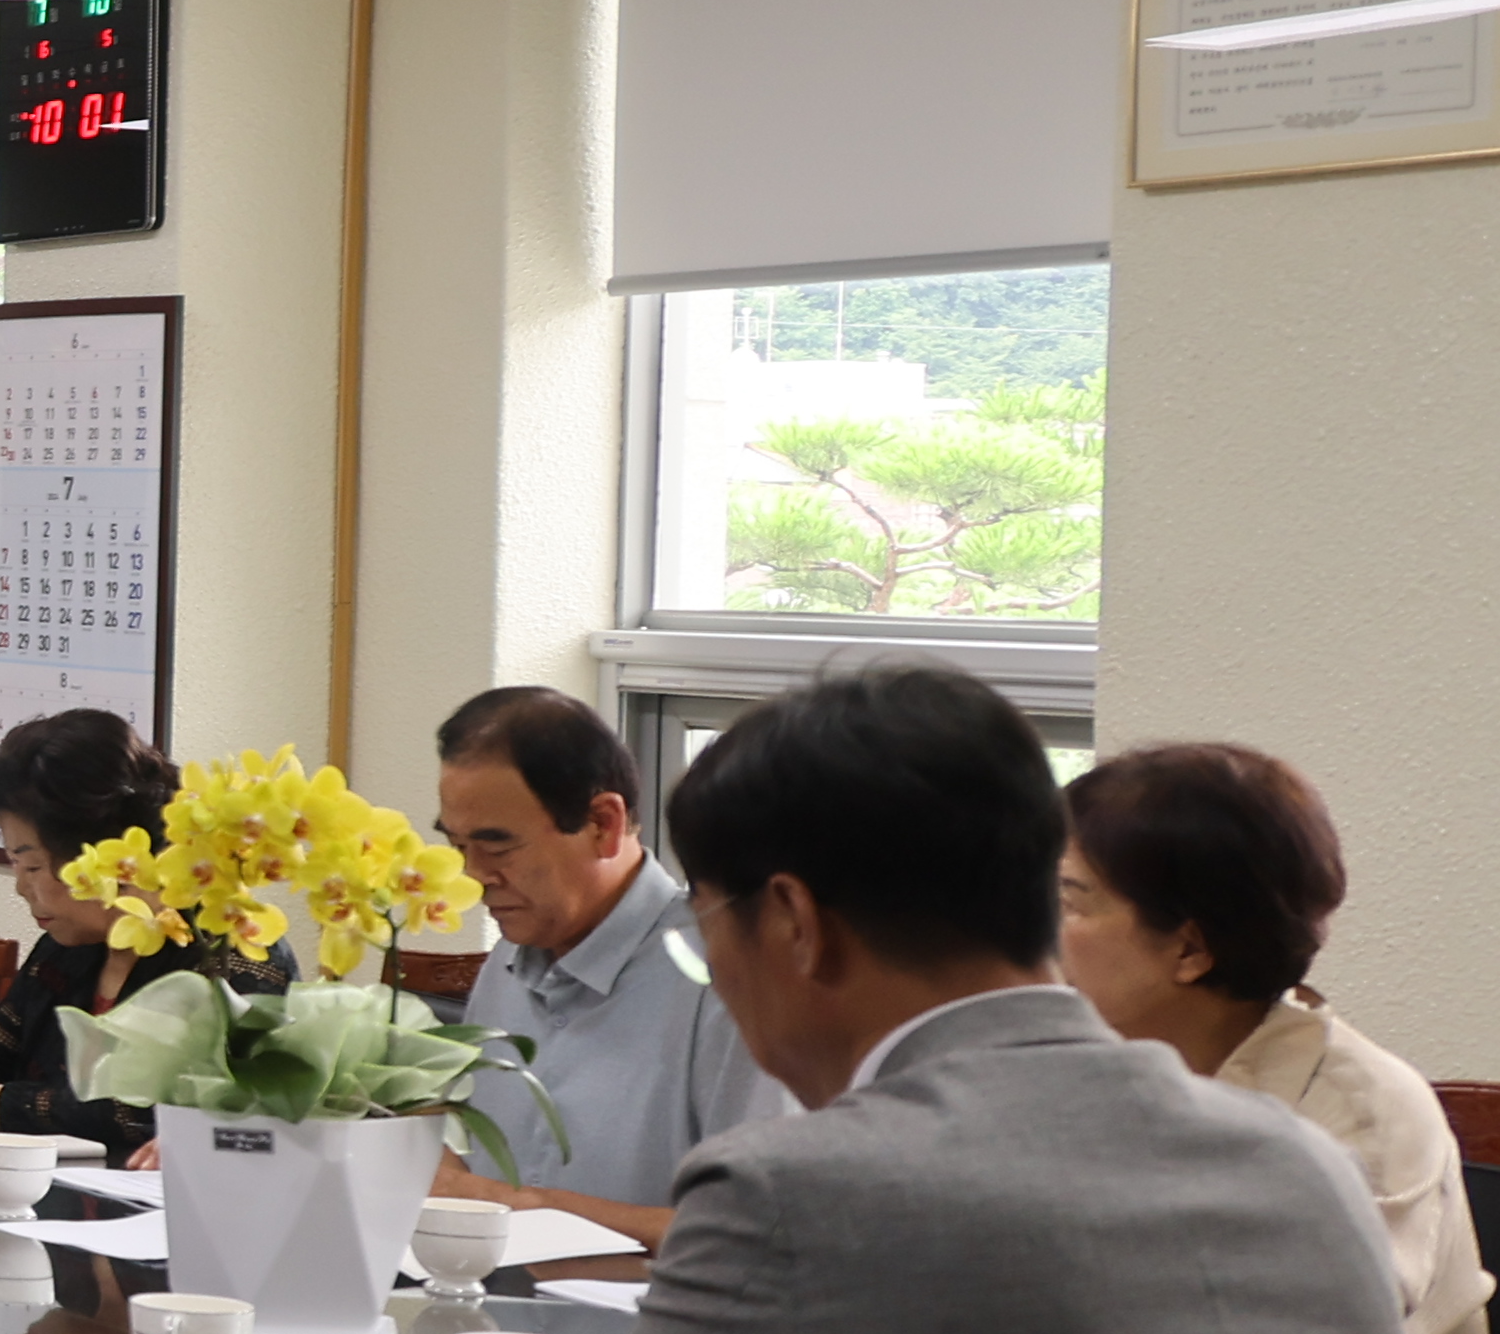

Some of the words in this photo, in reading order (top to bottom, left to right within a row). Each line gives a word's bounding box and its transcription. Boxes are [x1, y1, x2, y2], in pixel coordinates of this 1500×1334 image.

[37, 40, 50, 58] 6
[101, 28, 113, 48] 5
[71, 333, 78, 349] 6
[139, 365, 144, 377] 1
[7, 388, 12, 400] 2
[27, 388, 32, 400] 3
[48, 388, 54, 399] 4
[70, 387, 76, 399] 5
[92, 387, 97, 399] 6
[115, 386, 121, 398] 7
[139, 386, 145, 398] 8
[6, 408, 11, 419] 9
[24, 408, 33, 419] 10
[45, 408, 55, 419] 11
[67, 407, 76, 419] 12
[89, 407, 99, 419] 13
[112, 407, 122, 418] 14
[137, 407, 146, 419] 15
[3, 428, 12, 440] 16
[24, 427, 33, 439] 17
[44, 428, 54, 439] 18
[66, 428, 75, 439] 19
[88, 428, 99, 440] 20
[112, 427, 121, 440] 21
[135, 428, 146, 440] 22
[23, 448, 32, 460] 24
[43, 448, 53, 460] 25
[65, 448, 75, 460] 26
[87, 448, 98, 460] 27
[111, 448, 122, 461] 28
[135, 448, 146, 461] 29
[64, 477, 74, 500] 7
[23, 521, 28, 537] 1
[43, 521, 50, 538] 2
[65, 522, 71, 538] 3
[87, 523, 94, 538] 4
[110, 523, 117, 540] 5
[133, 525, 141, 541] 6
[2, 548, 8, 563] 7
[22, 549, 28, 565] 8
[43, 550, 49, 566] 9
[62, 551, 73, 567] 10
[85, 552, 94, 568] 11
[107, 553, 119, 569] 12
[130, 554, 143, 570] 13
[0, 576, 10, 591] 14
[20, 577, 30, 593] 15
[40, 578, 51, 594] 16
[61, 579, 72, 595] 17
[83, 581, 95, 597] 18
[106, 582, 118, 598] 19
[128, 583, 142, 599] 20
[18, 605, 30, 621] 22
[39, 606, 51, 623] 23
[59, 608, 72, 624] 24
[81, 609, 94, 626] 25
[104, 611, 118, 627] 26
[128, 612, 142, 629] 27
[18, 633, 30, 649] 29
[38, 635, 50, 651] 30
[58, 636, 69, 652] 31
[61, 673, 67, 688] 8
